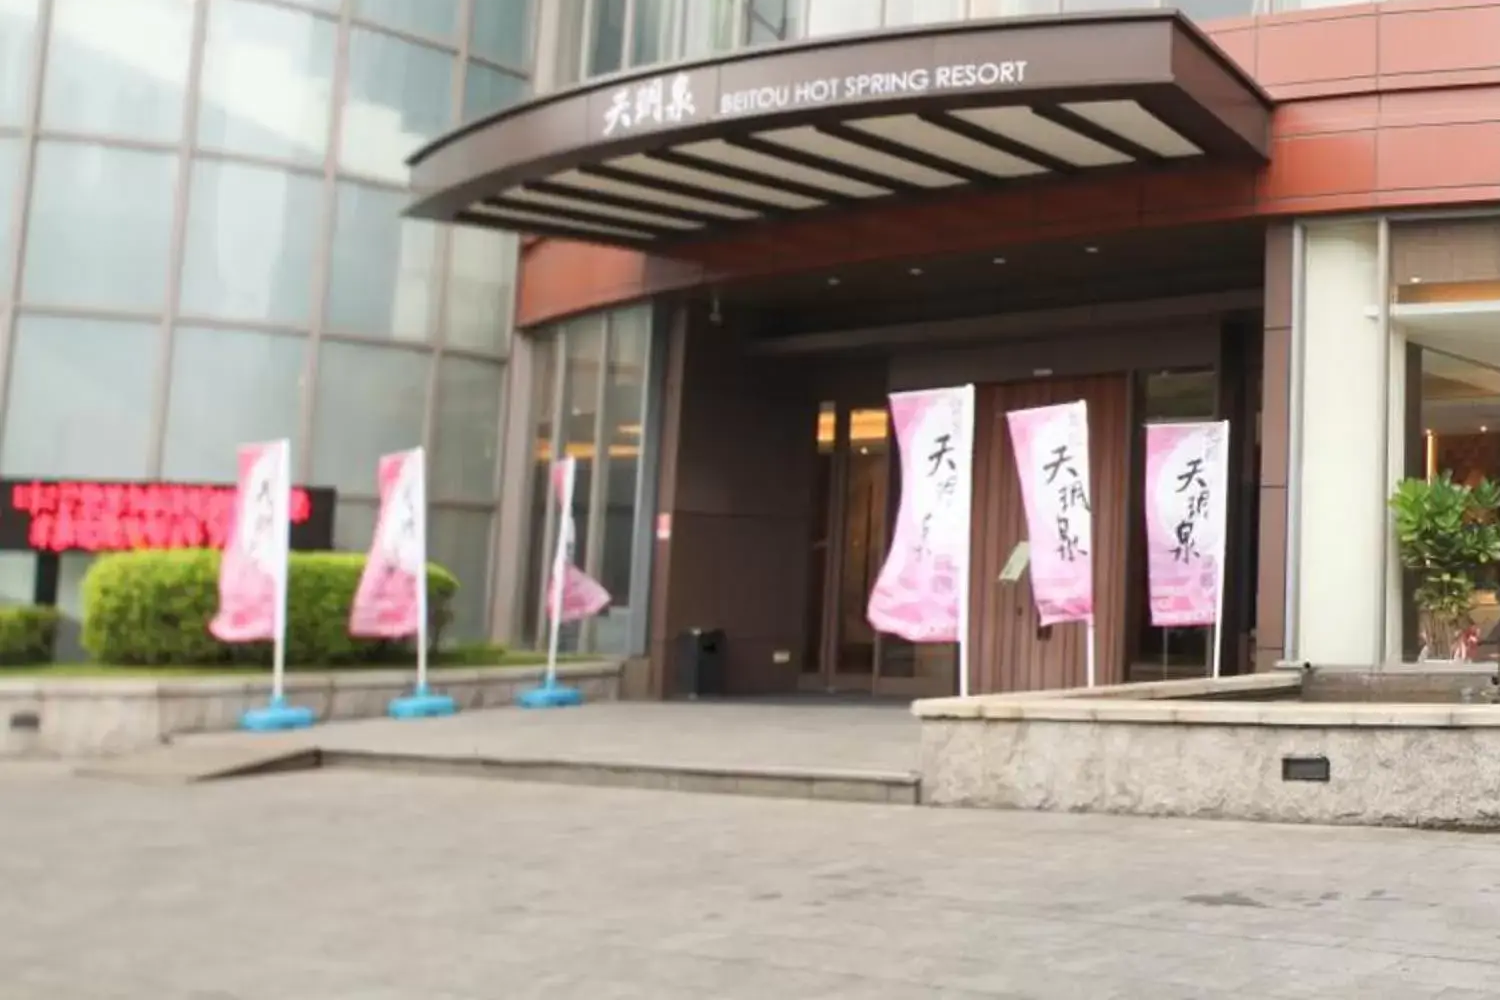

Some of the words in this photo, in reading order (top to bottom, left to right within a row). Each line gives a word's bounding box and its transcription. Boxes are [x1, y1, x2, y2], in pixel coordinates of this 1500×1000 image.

[720, 86, 789, 114] BEITOU
[795, 78, 839, 104] HOT
[844, 69, 929, 99] SPRING
[935, 60, 1028, 88] RESORT
